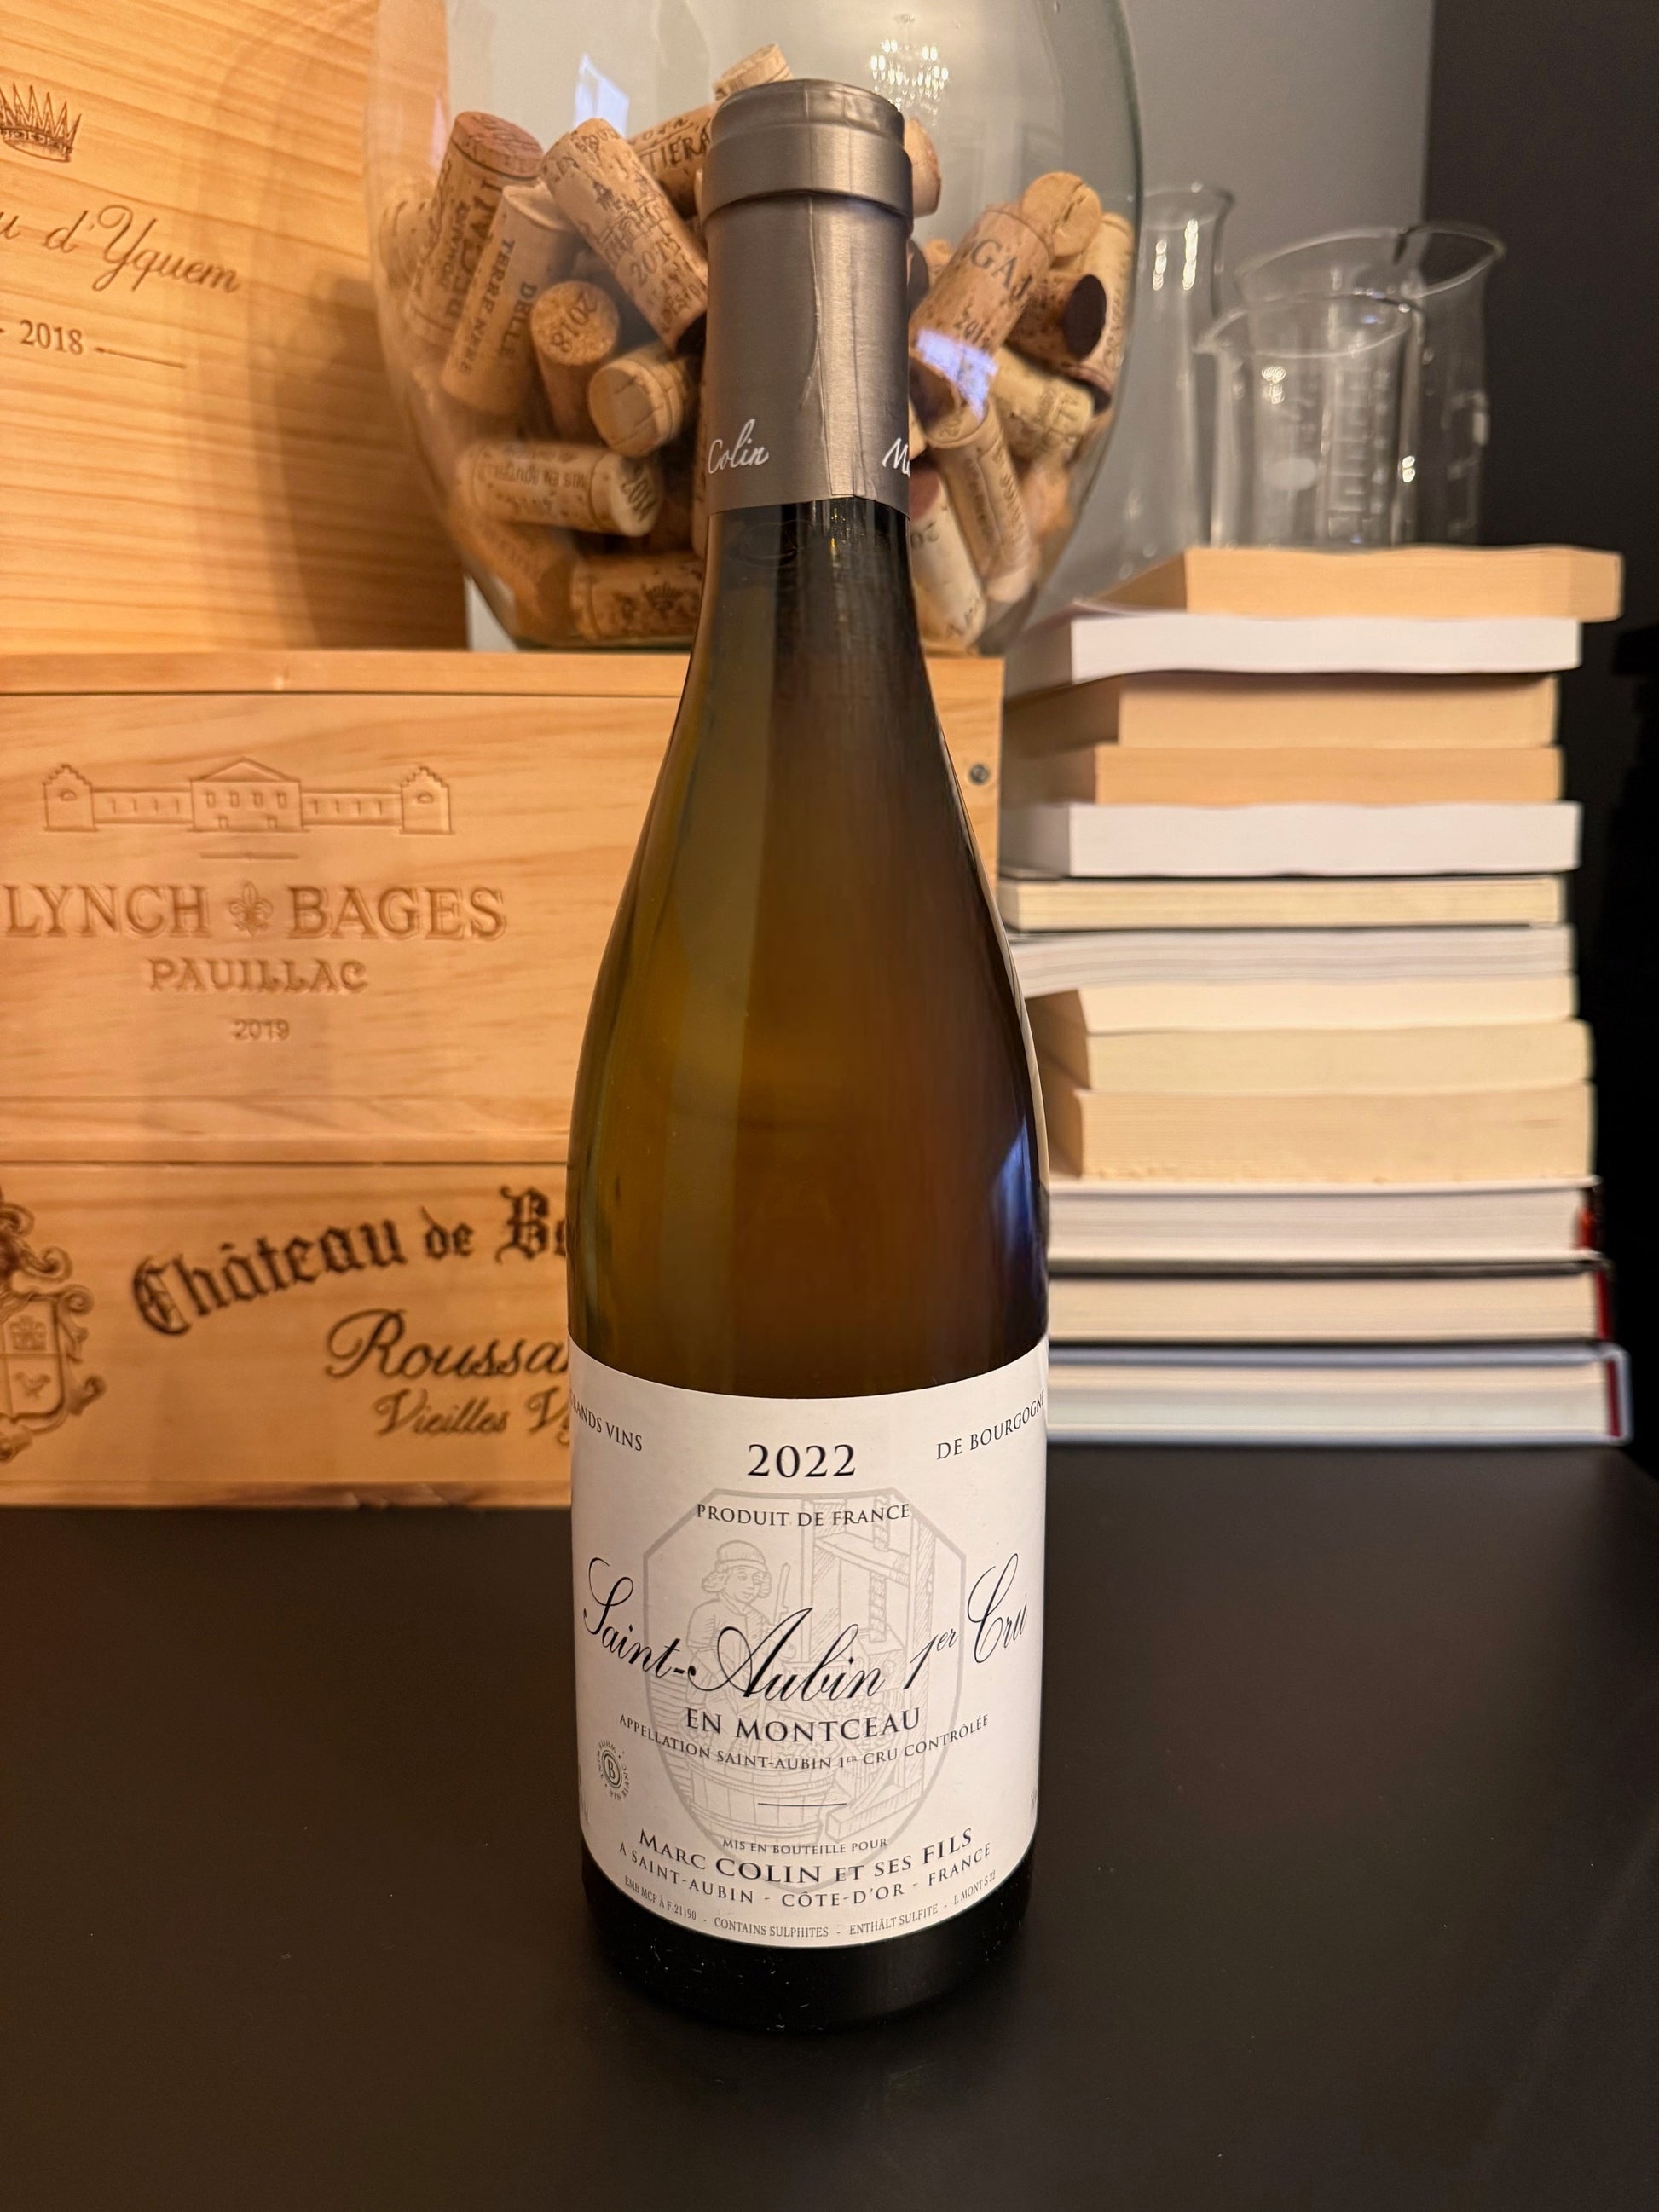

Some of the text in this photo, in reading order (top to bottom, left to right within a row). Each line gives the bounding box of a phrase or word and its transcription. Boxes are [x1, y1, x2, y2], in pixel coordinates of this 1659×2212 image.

[43, 205, 240, 292] d'Yquem
[20, 319, 84, 355] 2018
[552, 288, 597, 353] 2018
[708, 418, 769, 474] Colin
[3, 883, 507, 940] LYNCH BAGES
[147, 958, 368, 993] PAUILLAC
[233, 1019, 290, 1041] 2019
[131, 1217, 409, 1337] Château
[420, 1207, 476, 1260] de
[374, 1388, 508, 1436] Vieilles
[605, 1422, 643, 1451] VINS
[936, 1389, 1045, 1460] DE BOURGOGNE
[747, 1443, 857, 1479] 2022
[697, 1503, 910, 1528] PRODUIT DE FRANCE
[583, 1553, 1027, 1702] Saint-Aubin 1er Cru
[620, 1714, 710, 1759] APPELLATION
[717, 1750, 831, 1770] SAINT-AUBIN
[863, 1748, 898, 1765] CRU
[904, 1713, 989, 1758] CONTRÔLÉE
[685, 1707, 922, 1742] EN MONTCEAU
[608, 1759, 616, 1779] B
[639, 1828, 972, 1883] MARC COLIN ET SES FILS
[722, 1838, 887, 1855] MIS EN BOUTEILLE POUR
[631, 1850, 753, 1903] SAINT-AUBIN
[782, 1883, 905, 1908] CÔTE-D'OR
[928, 1842, 991, 1886] FRANCE
[625, 1875, 639, 1893] EMB
[641, 1886, 657, 1903] MCF
[667, 1900, 697, 1920] F-21190
[714, 1917, 766, 1936] CONTAINS
[769, 1926, 829, 1937] SULPHITES
[849, 1916, 896, 1935] ENTHÄLT
[899, 1903, 939, 1926] SULFITE
[954, 1894, 959, 1905] L
[961, 1879, 983, 1901] MONT
